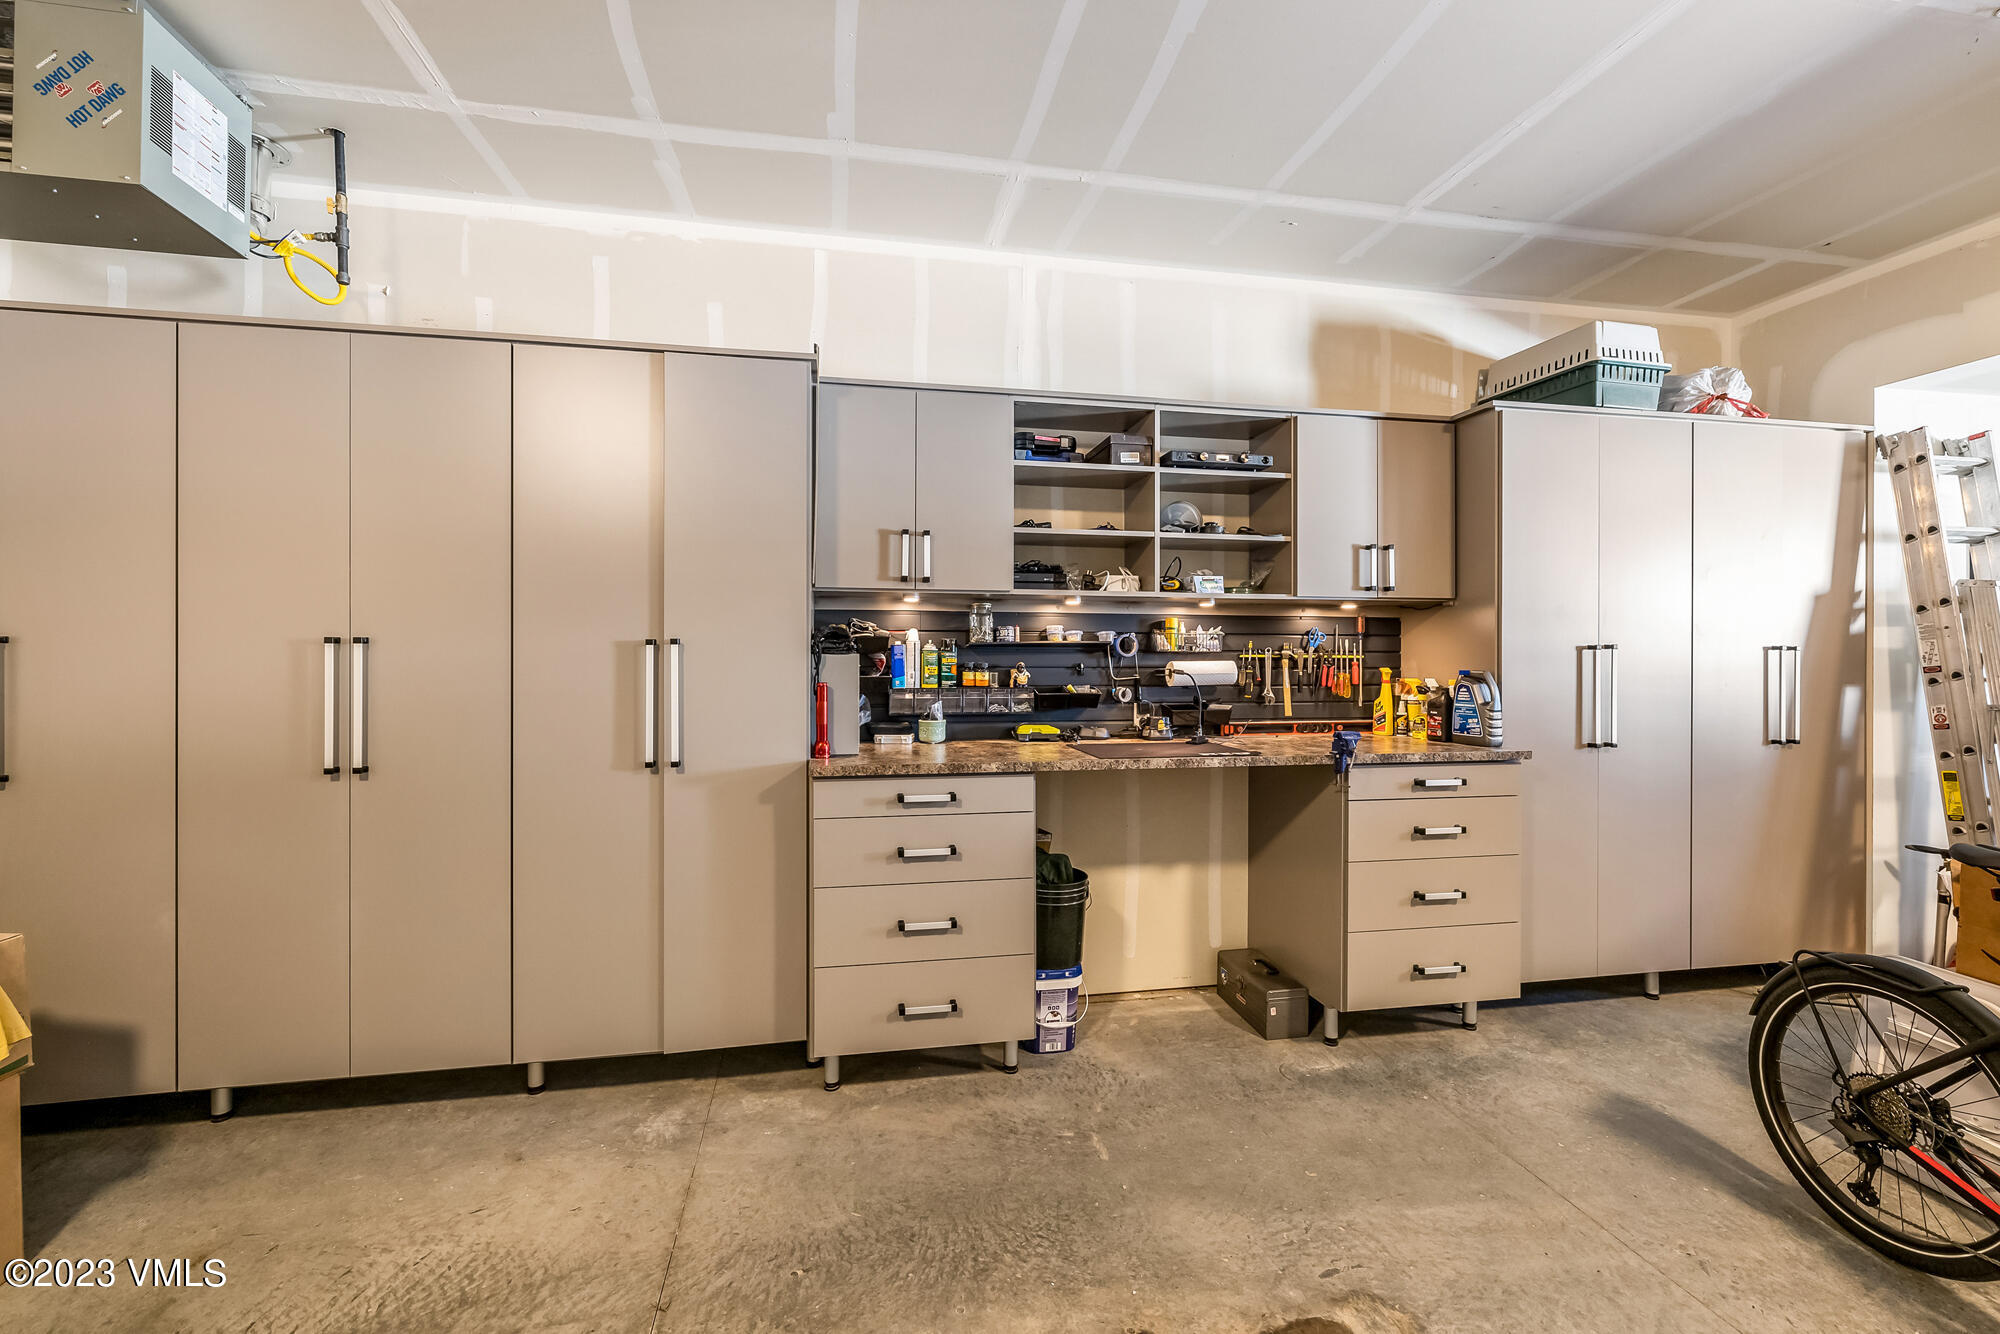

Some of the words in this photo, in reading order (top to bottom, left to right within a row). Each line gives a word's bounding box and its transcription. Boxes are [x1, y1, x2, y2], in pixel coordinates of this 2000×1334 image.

[66, 50, 95, 74] HOT
[33, 66, 72, 96] DAWG
[65, 104, 93, 129] HOT
[88, 82, 127, 112] DAWG
